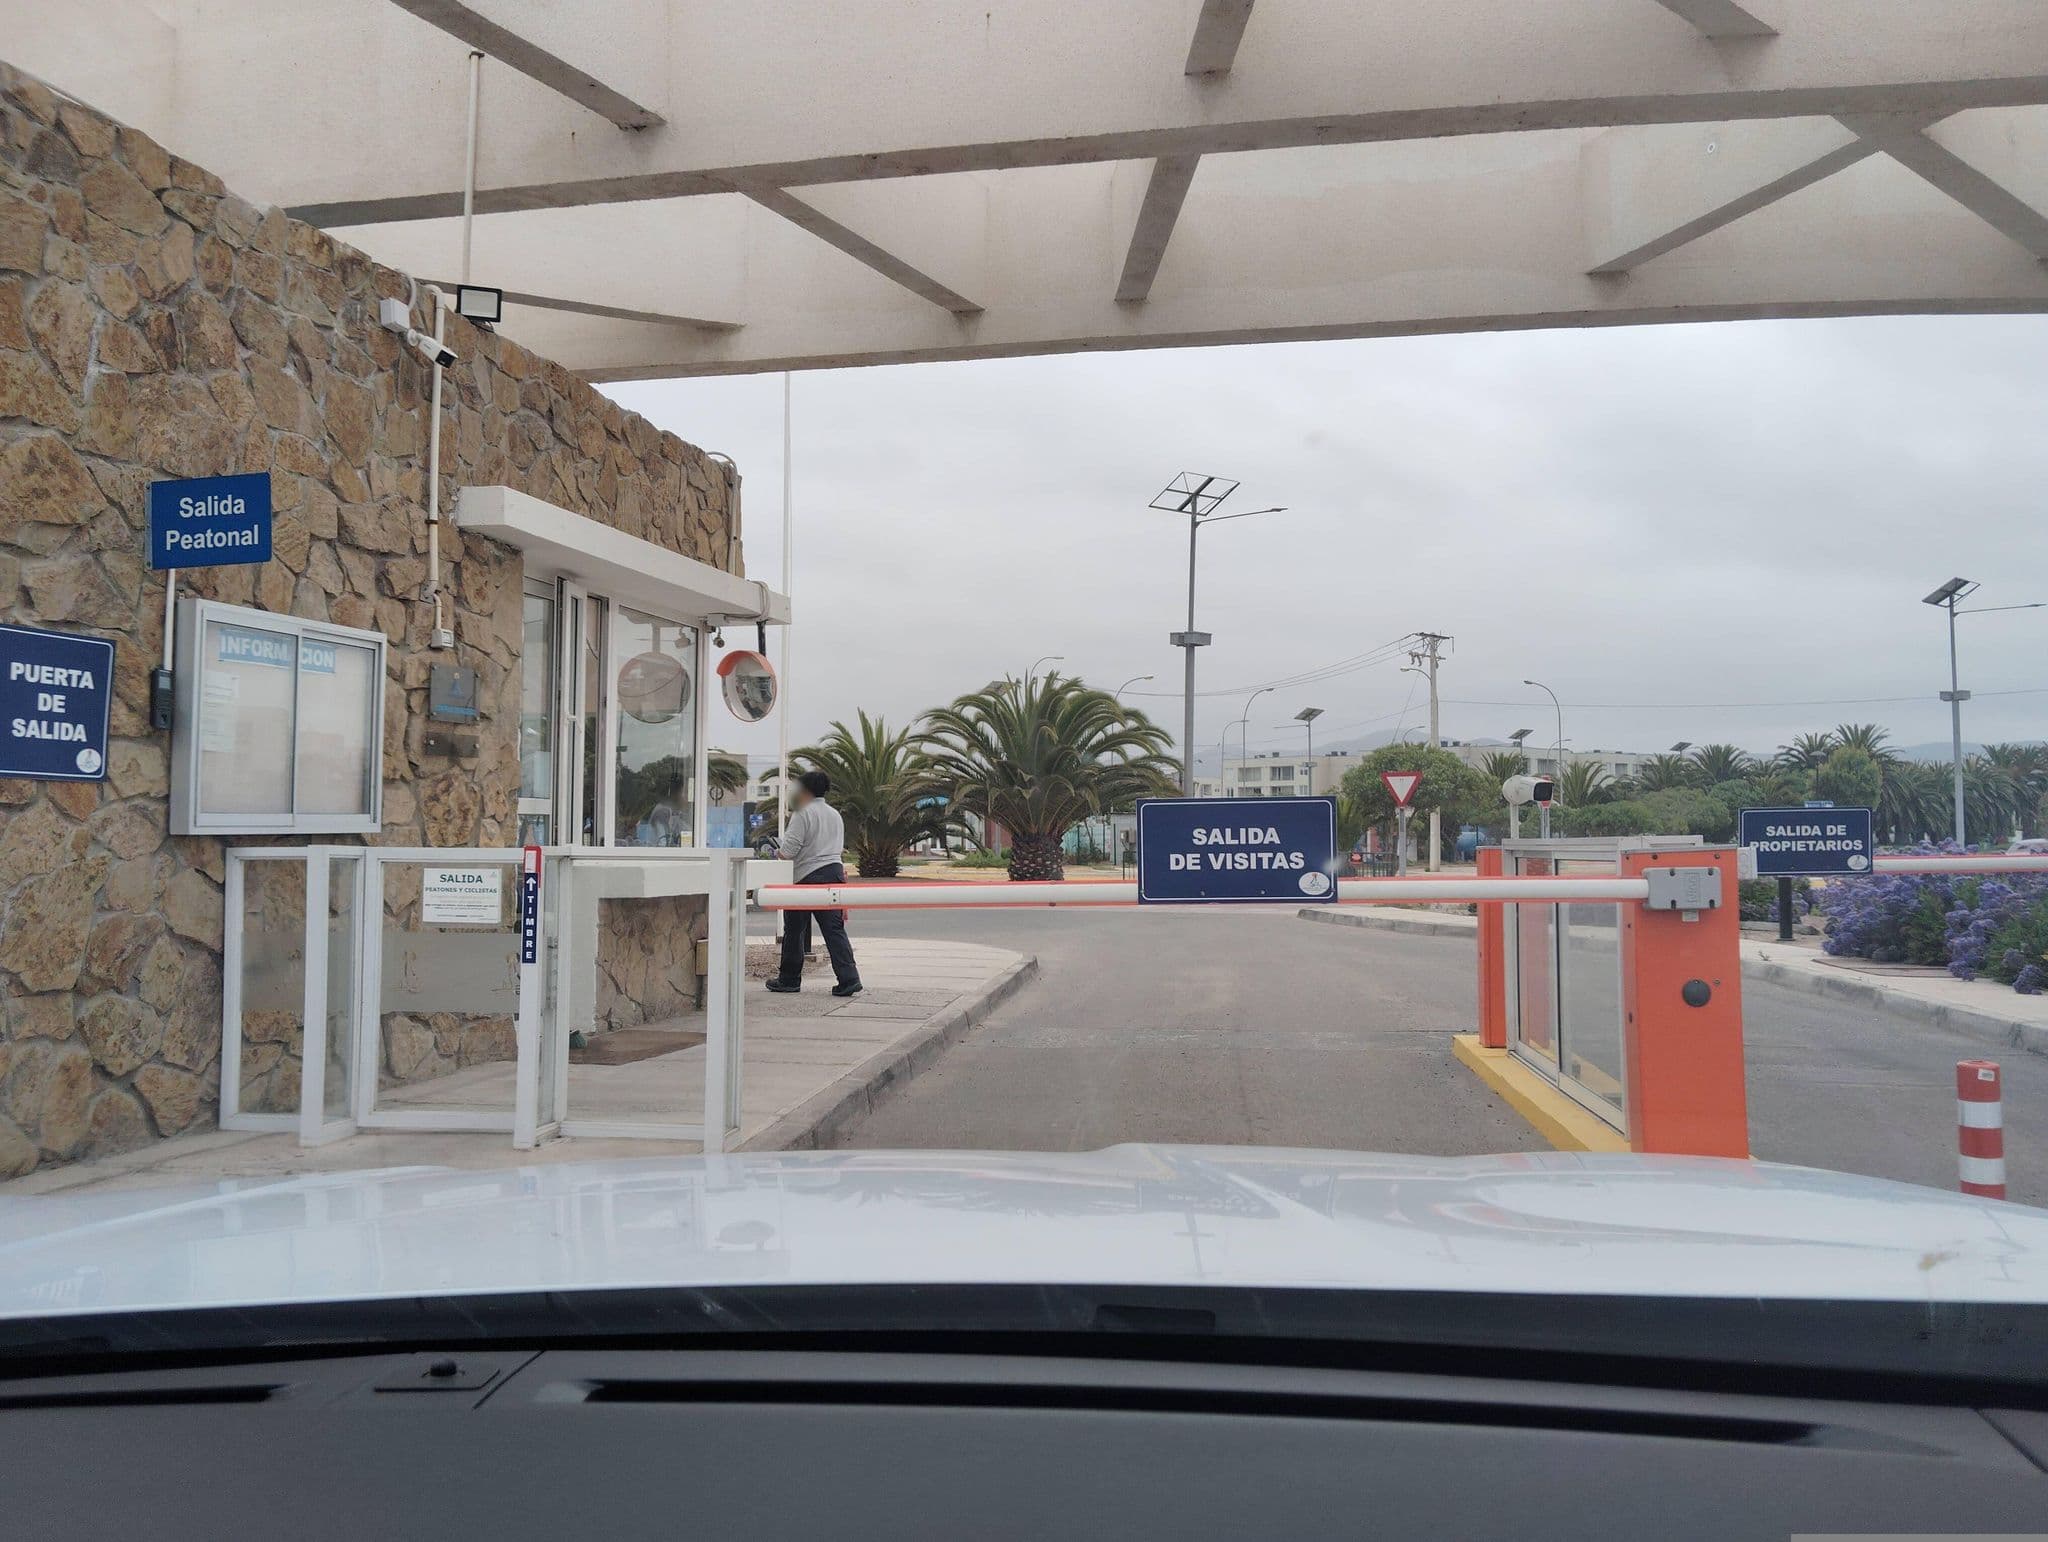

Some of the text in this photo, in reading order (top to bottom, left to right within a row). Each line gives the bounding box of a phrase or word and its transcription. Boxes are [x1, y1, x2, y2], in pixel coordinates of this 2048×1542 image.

[179, 494, 246, 518] Salida
[165, 524, 259, 551] Peatonal
[219, 634, 335, 668] INFORMCION
[10, 662, 95, 690] PUERTA
[37, 693, 66, 713] DE
[11, 718, 88, 742] SALIDA
[1192, 827, 1280, 845] SALIDA
[1766, 824, 1847, 836] SALIDA DE
[1750, 840, 1864, 852] PROPIETARIOS
[1169, 852, 1305, 871] DE VISITAS
[439, 874, 483, 883] SALIDA
[525, 895, 535, 959] TIMBRE
